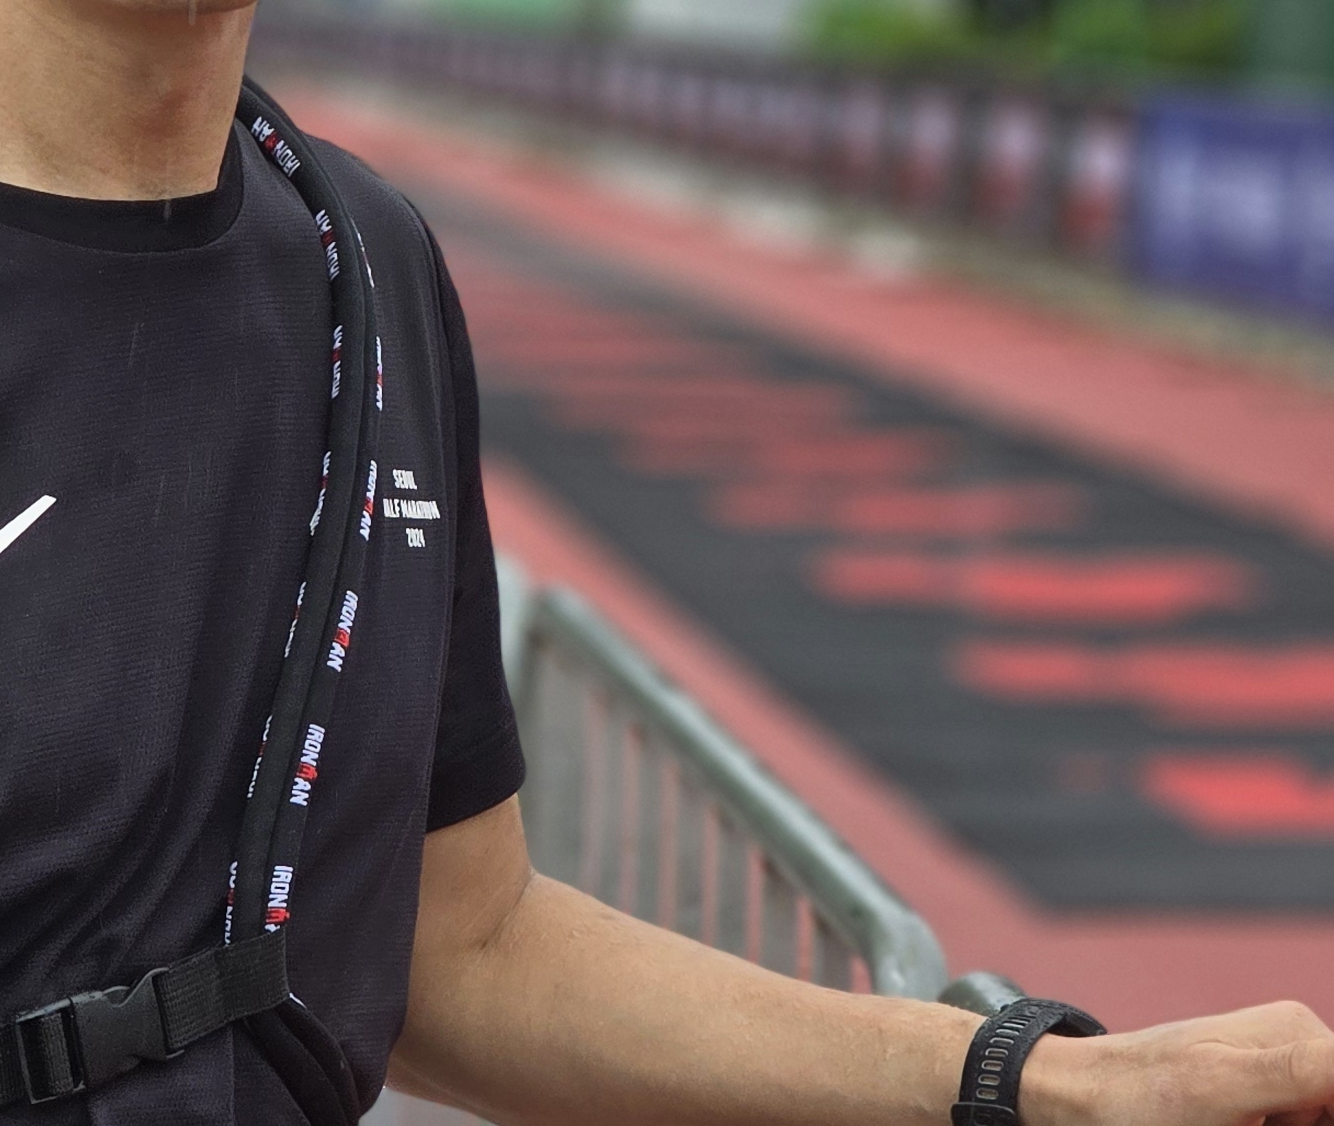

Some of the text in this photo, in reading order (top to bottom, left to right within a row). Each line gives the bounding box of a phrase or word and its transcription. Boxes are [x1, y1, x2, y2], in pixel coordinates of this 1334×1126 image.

[327, 590, 359, 673] IRONMAN
[290, 724, 326, 807] IRONMAN
[264, 865, 294, 933] IRONM
